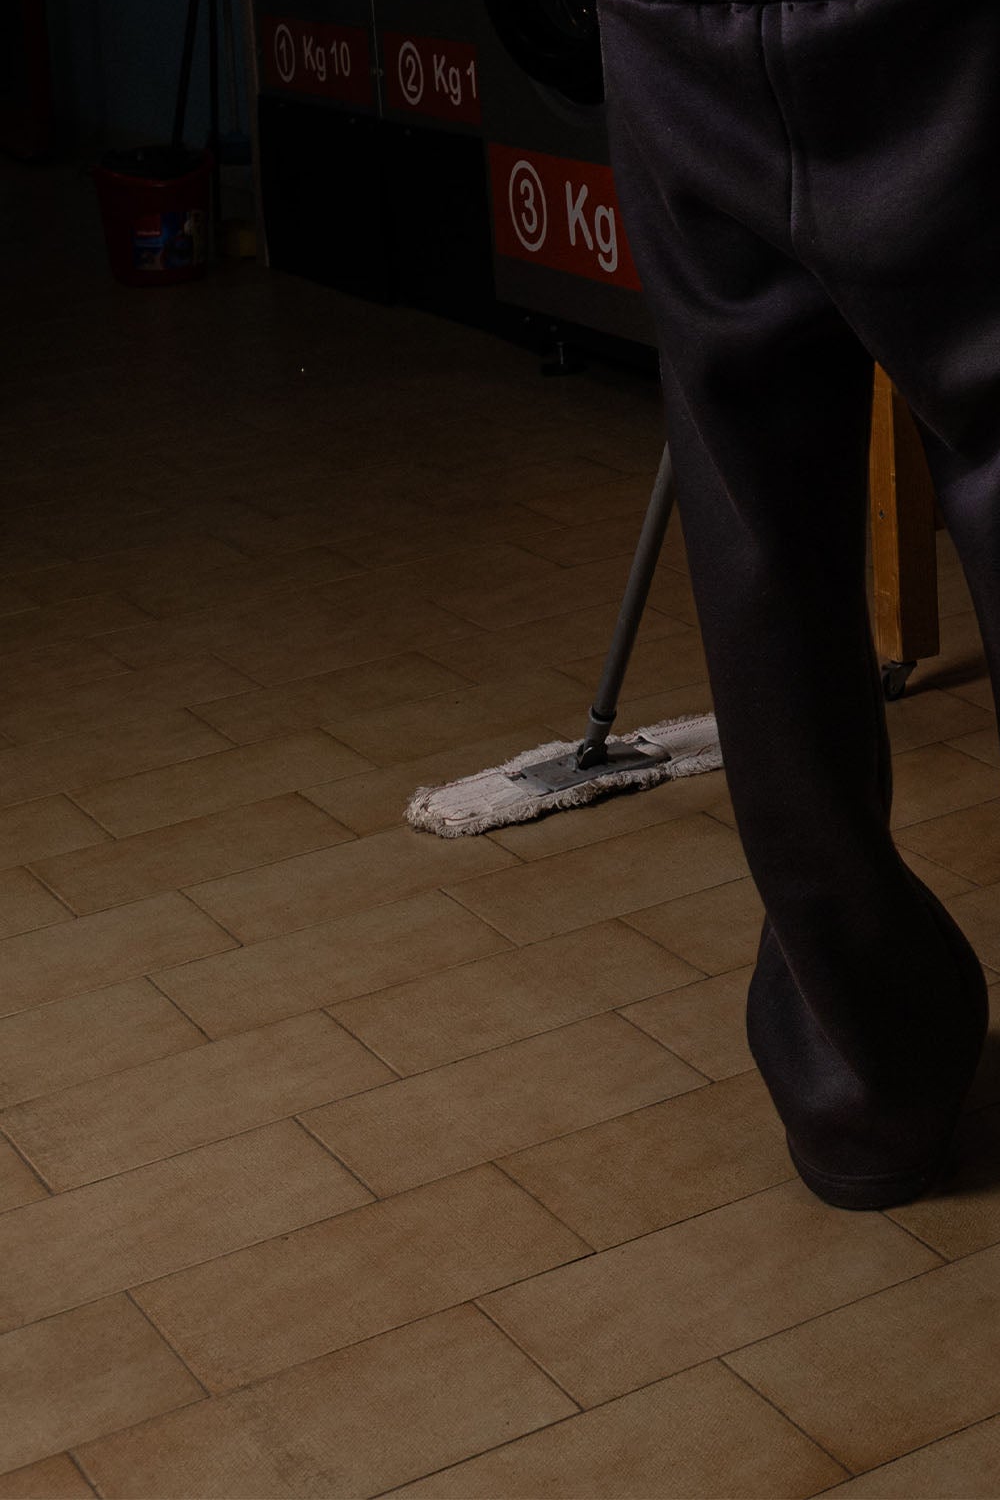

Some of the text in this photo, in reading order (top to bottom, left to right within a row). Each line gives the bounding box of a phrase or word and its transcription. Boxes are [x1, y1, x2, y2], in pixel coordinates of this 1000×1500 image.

[303, 35, 326, 82] Kg
[330, 39, 350, 76] 10
[433, 53, 462, 106] Kg
[565, 180, 618, 273] Kg
